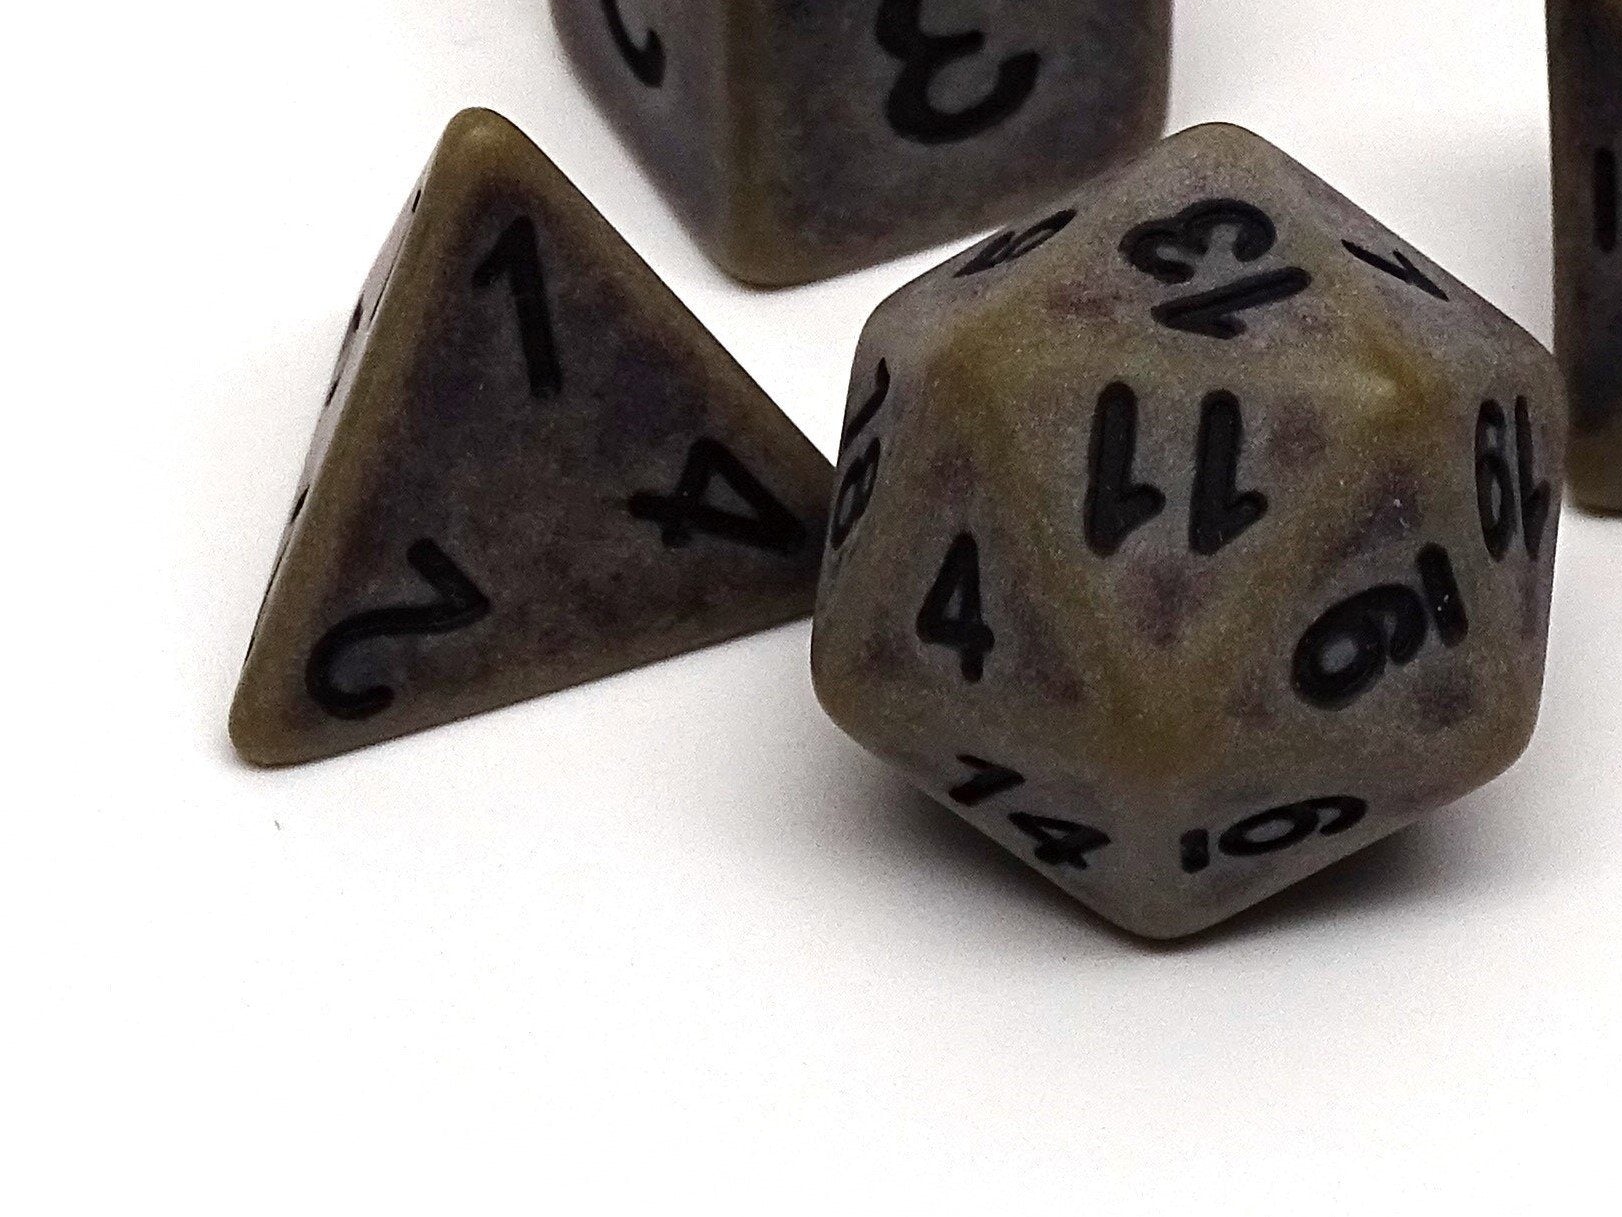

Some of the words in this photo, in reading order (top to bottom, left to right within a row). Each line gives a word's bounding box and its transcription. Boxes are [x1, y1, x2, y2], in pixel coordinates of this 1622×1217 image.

[470, 214, 564, 401] 1
[1118, 197, 1313, 340] 13
[628, 439, 808, 554] 4
[1083, 380, 1270, 558] 11
[304, 537, 491, 722] 2
[916, 531, 996, 682] 4
[946, 754, 1112, 872] 14
